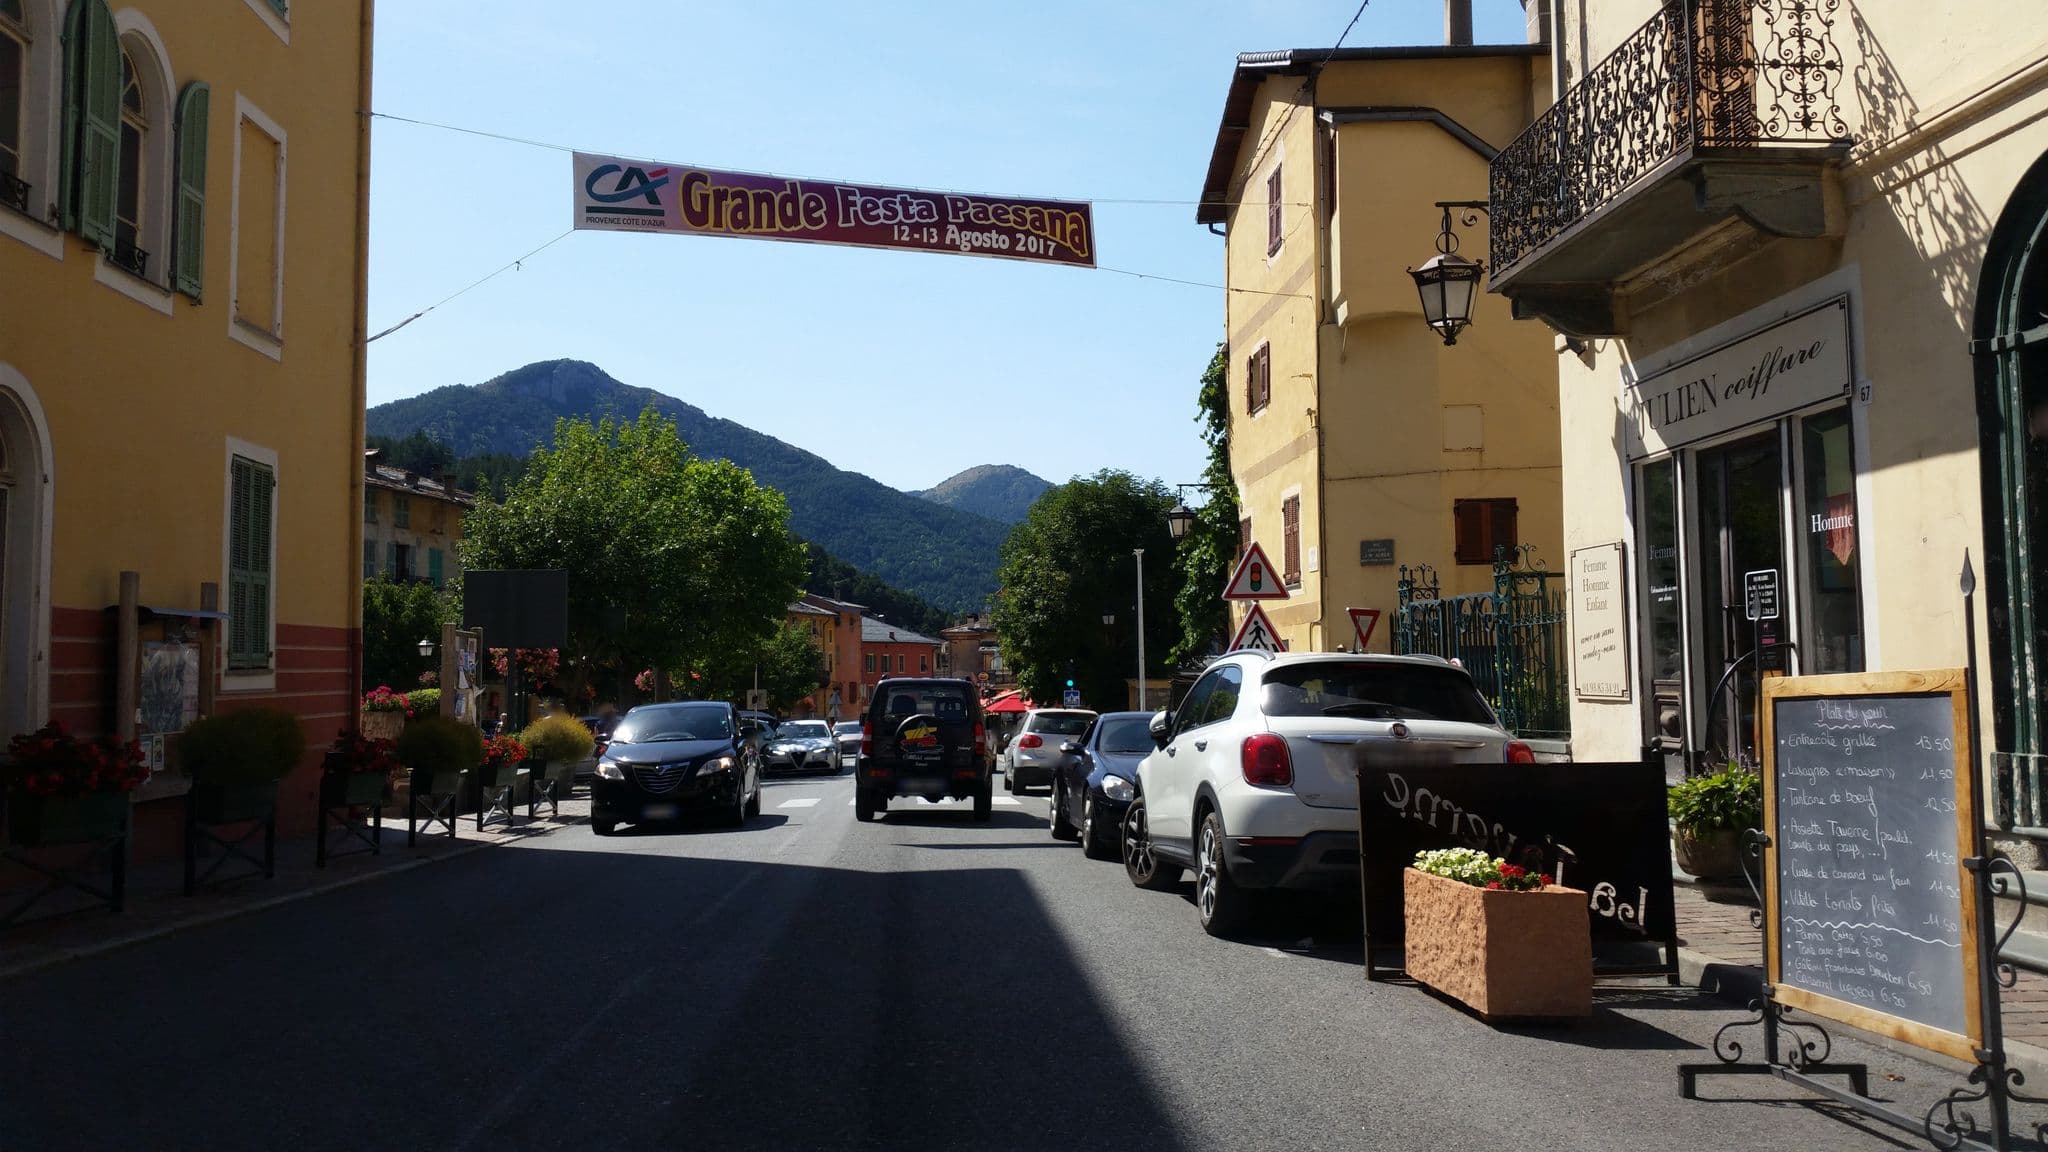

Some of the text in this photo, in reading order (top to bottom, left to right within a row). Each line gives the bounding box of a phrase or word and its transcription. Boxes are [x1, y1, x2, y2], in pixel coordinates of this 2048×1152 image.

[586, 216, 622, 225] PROVENCE
[641, 218, 665, 227] D'AZUR
[678, 168, 1090, 258] Grande Festa Paesana
[945, 224, 1010, 253] Agosto
[1015, 232, 1058, 257] 2017
[1637, 337, 1826, 440] JULIEN coiffure
[1860, 385, 1871, 402] 67
[1811, 512, 1854, 534] Homme
[1583, 559, 1608, 573] Femme
[1582, 578, 1609, 593] Homme
[1586, 597, 1608, 611] Enfant
[1817, 700, 1843, 722] Plats
[1844, 703, 1858, 720] du
[1788, 731, 1838, 747] Entrecôte
[1788, 757, 1830, 785] Lasagnes
[1830, 788, 1842, 803] de
[1826, 819, 1872, 841] Taverne
[1817, 865, 1829, 879] de
[1832, 868, 1866, 881] canard
